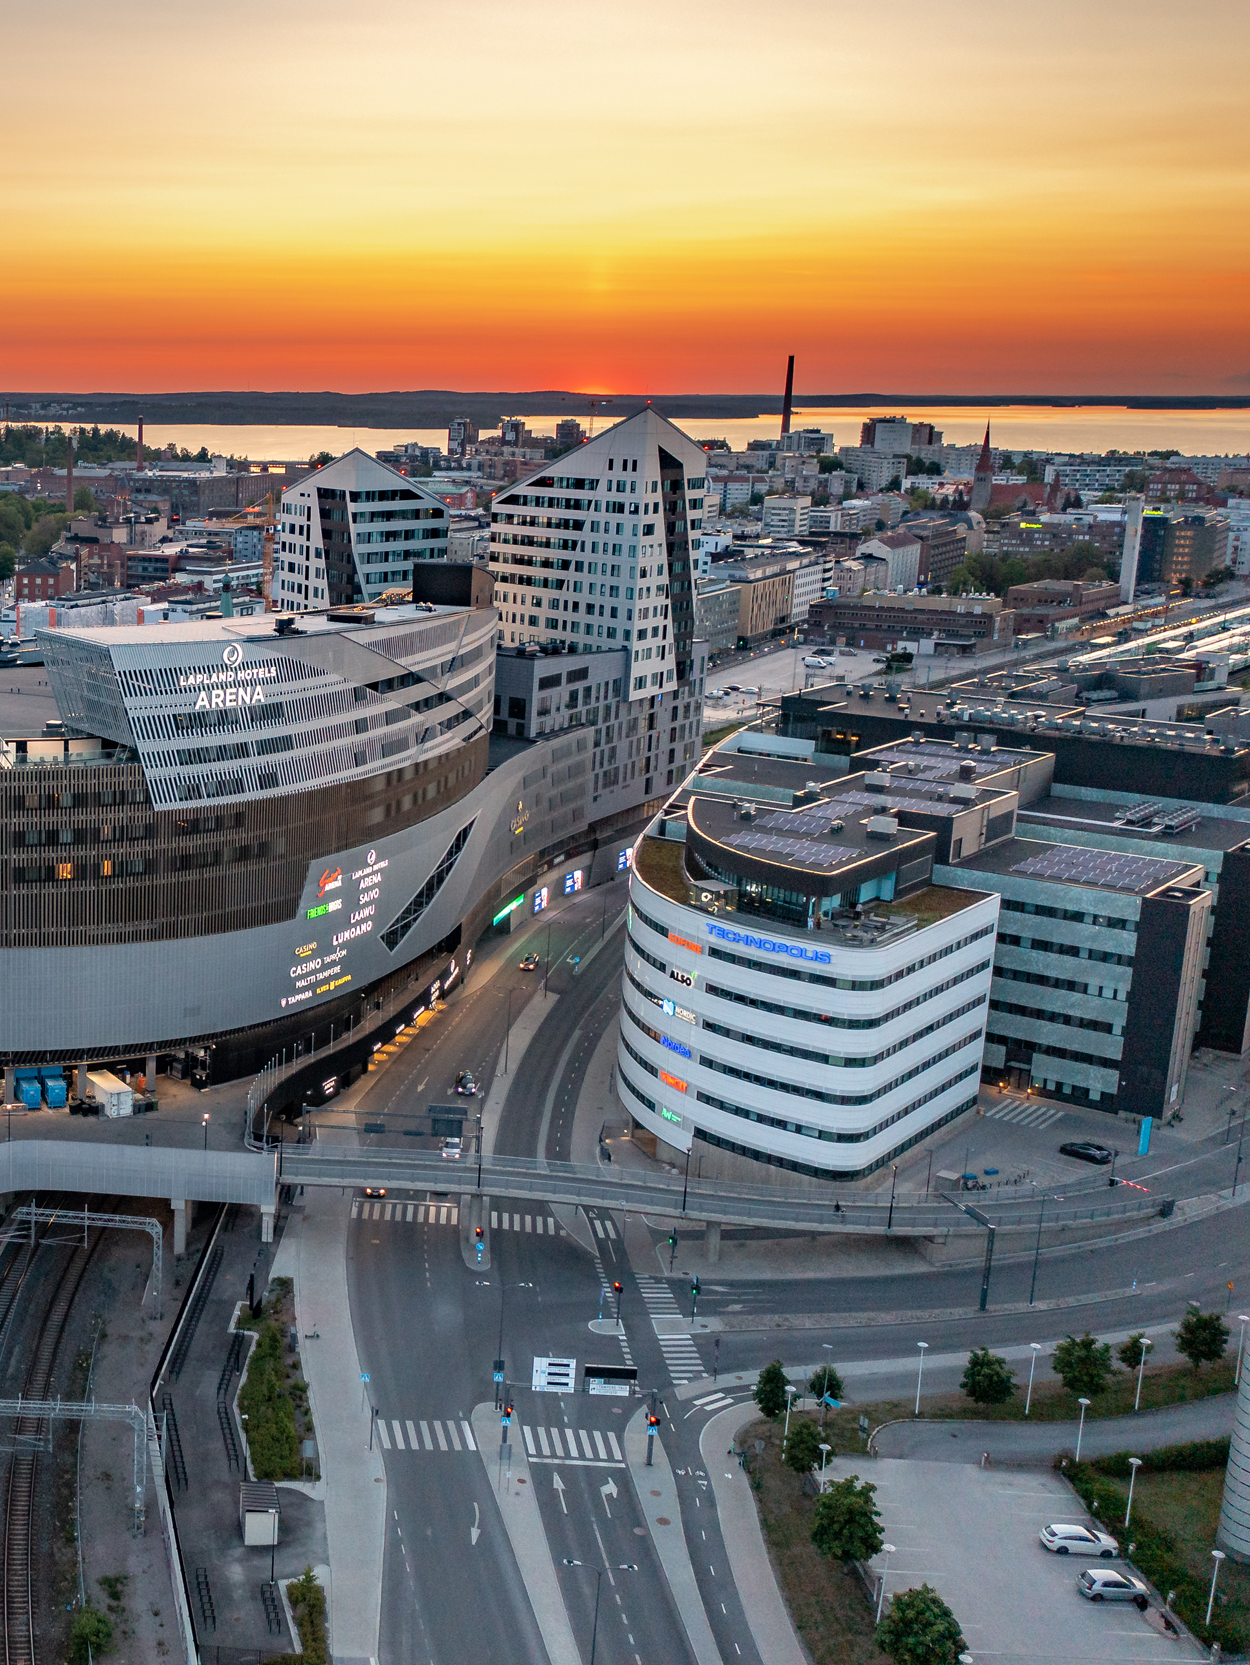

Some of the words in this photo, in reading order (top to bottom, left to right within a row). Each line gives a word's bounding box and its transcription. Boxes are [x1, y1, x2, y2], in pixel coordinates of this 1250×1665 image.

[180, 671, 235, 686] LAPLAND
[238, 666, 277, 681] HOTELS
[194, 686, 266, 710] ARENA
[510, 810, 530, 830] CASINO
[359, 872, 382, 890] ARENA
[359, 888, 380, 905] SAIVO
[350, 904, 375, 924] LAAWU
[332, 920, 373, 945] LUMOAMO
[295, 942, 317, 955] CASINO
[668, 933, 702, 955] GOFORE
[706, 922, 832, 964] TECHNOPOLIS
[290, 958, 322, 977] CASINO
[323, 947, 347, 964] TAPROOM
[316, 965, 342, 981] TAMPERE
[670, 969, 692, 986] ALSO
[288, 990, 313, 1004] TAPPARA
[675, 1006, 697, 1022] NORDIC
[661, 1035, 691, 1058] Nordea
